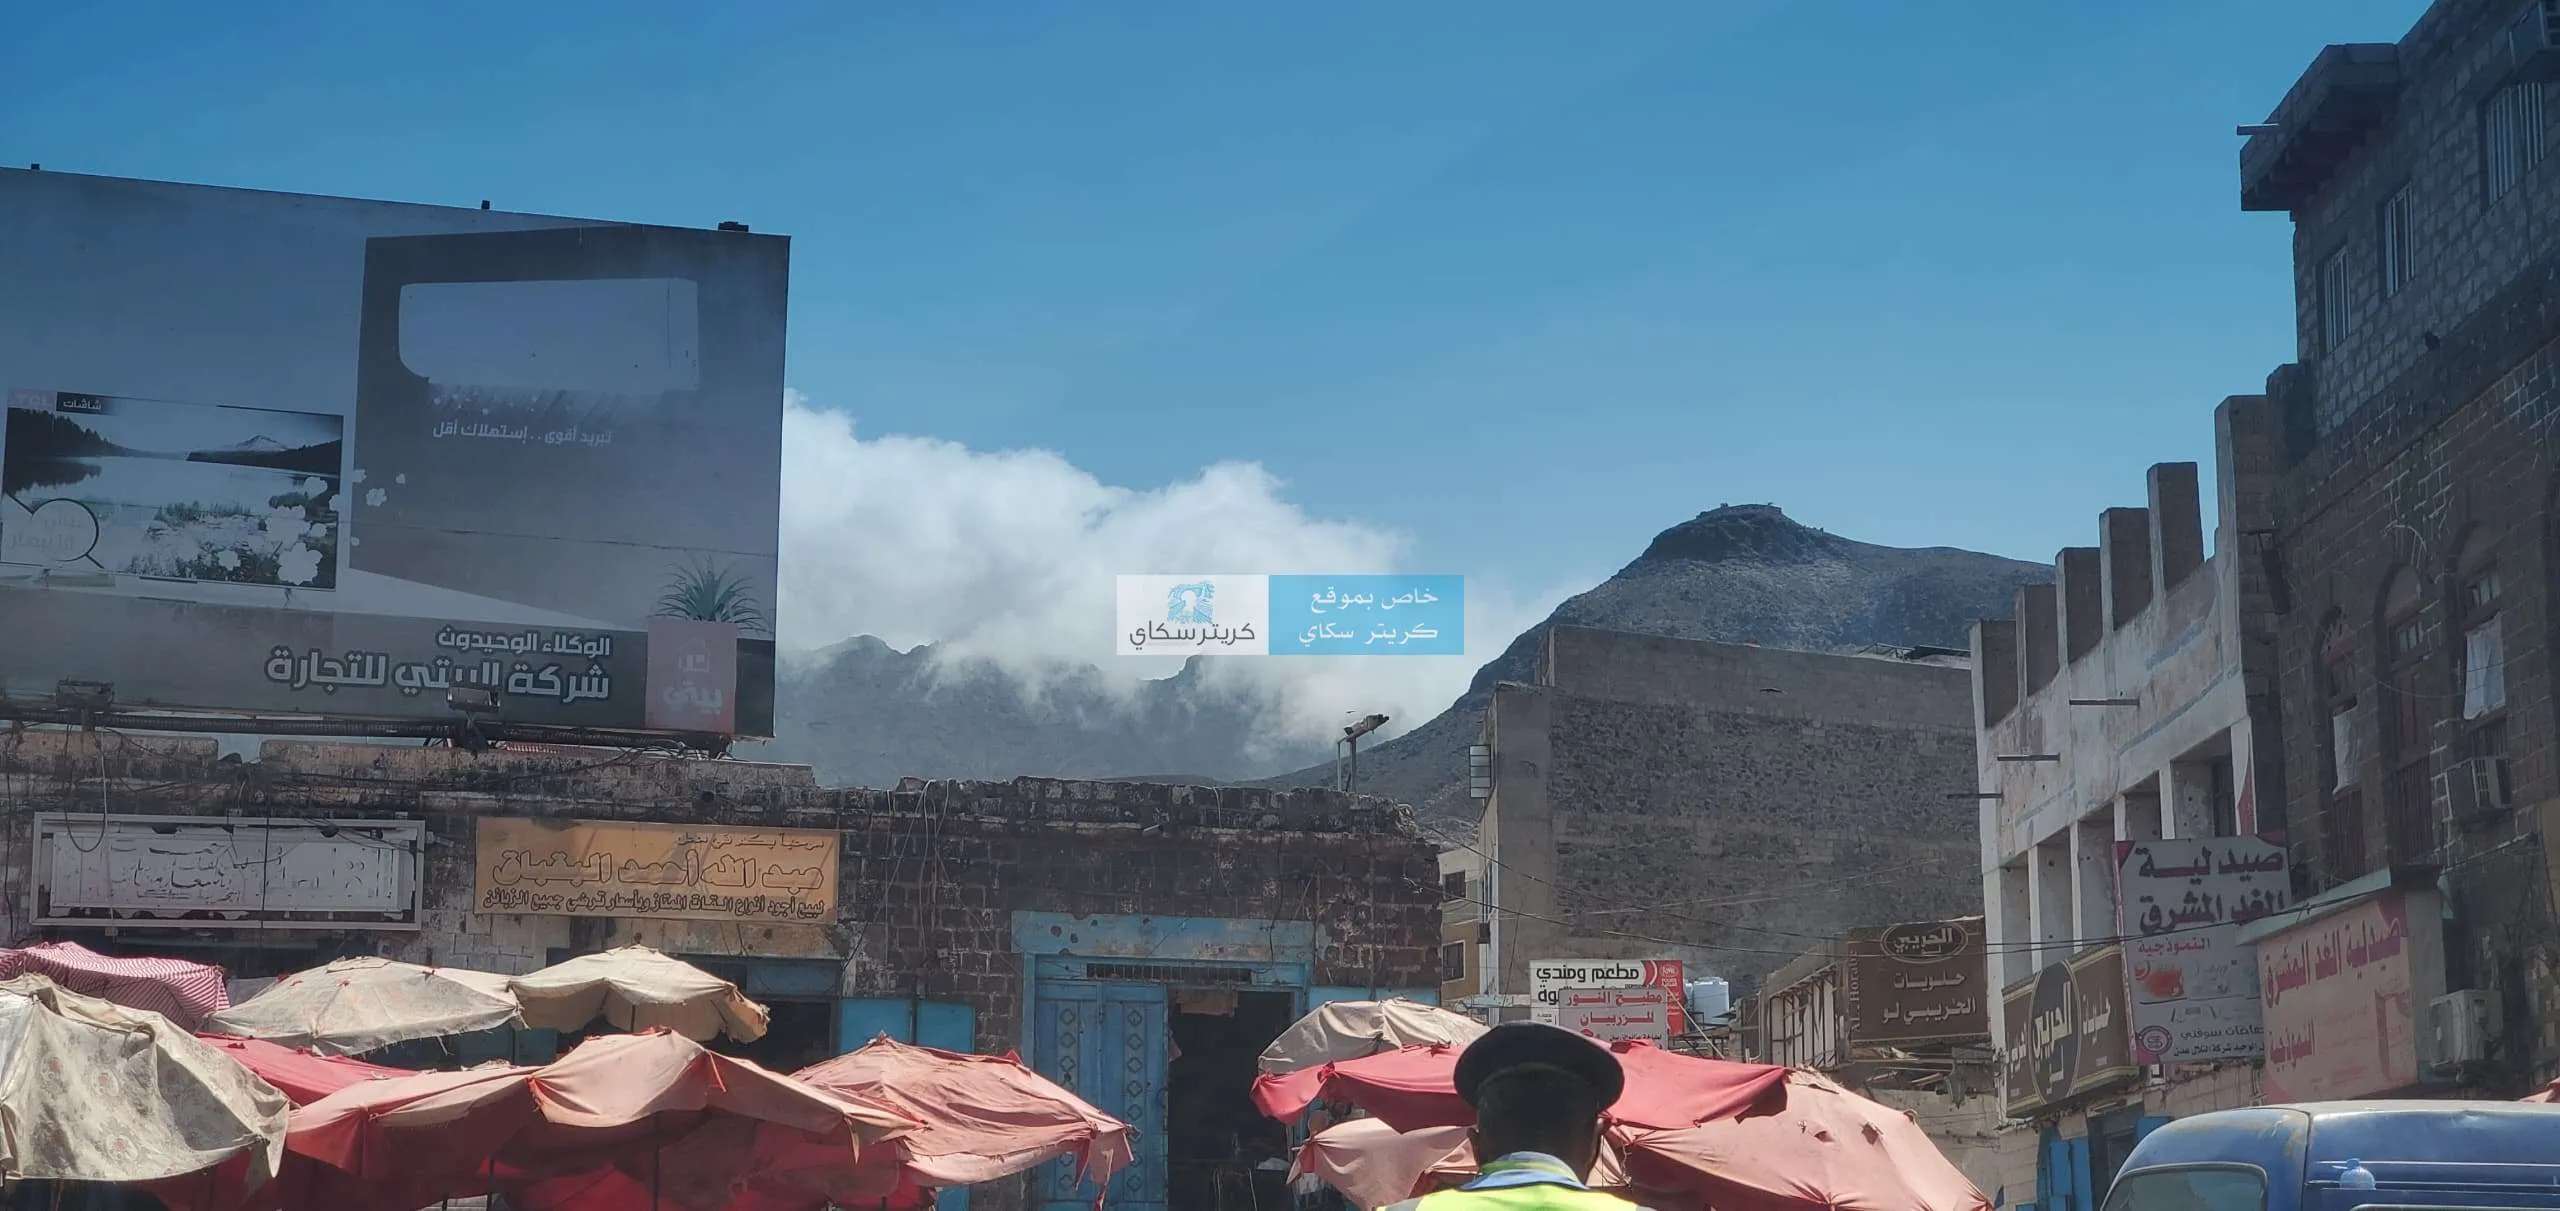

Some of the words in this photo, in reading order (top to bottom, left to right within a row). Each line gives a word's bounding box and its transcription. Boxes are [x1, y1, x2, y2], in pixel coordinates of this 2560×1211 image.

[63, 398, 102, 411] شاشات
[432, 418, 459, 438] أقل
[460, 423, 528, 444] إستهلاك
[437, 626, 537, 652] الوحيدون
[541, 635, 611, 658] الوكلاء
[267, 648, 387, 693] للتجارة
[507, 663, 610, 704] شركة
[700, 854, 757, 889] الله
[2134, 846, 2283, 885] صيدلية
[761, 864, 825, 896] عبد
[530, 892, 565, 911] جميع
[688, 894, 734, 912] القات
[796, 899, 824, 918] لبيع
[2138, 891, 2223, 934] المشرق
[2315, 928, 2342, 982] الغد
[2345, 917, 2401, 980] صيدلية
[1536, 965, 1587, 984] ومندي
[1591, 963, 1640, 983] مطعم
[1893, 968, 1968, 992] حلويات
[2265, 939, 2311, 1010] المشرق
[1567, 990, 1611, 1007] النور
[1615, 990, 1663, 1007] مطبخ
